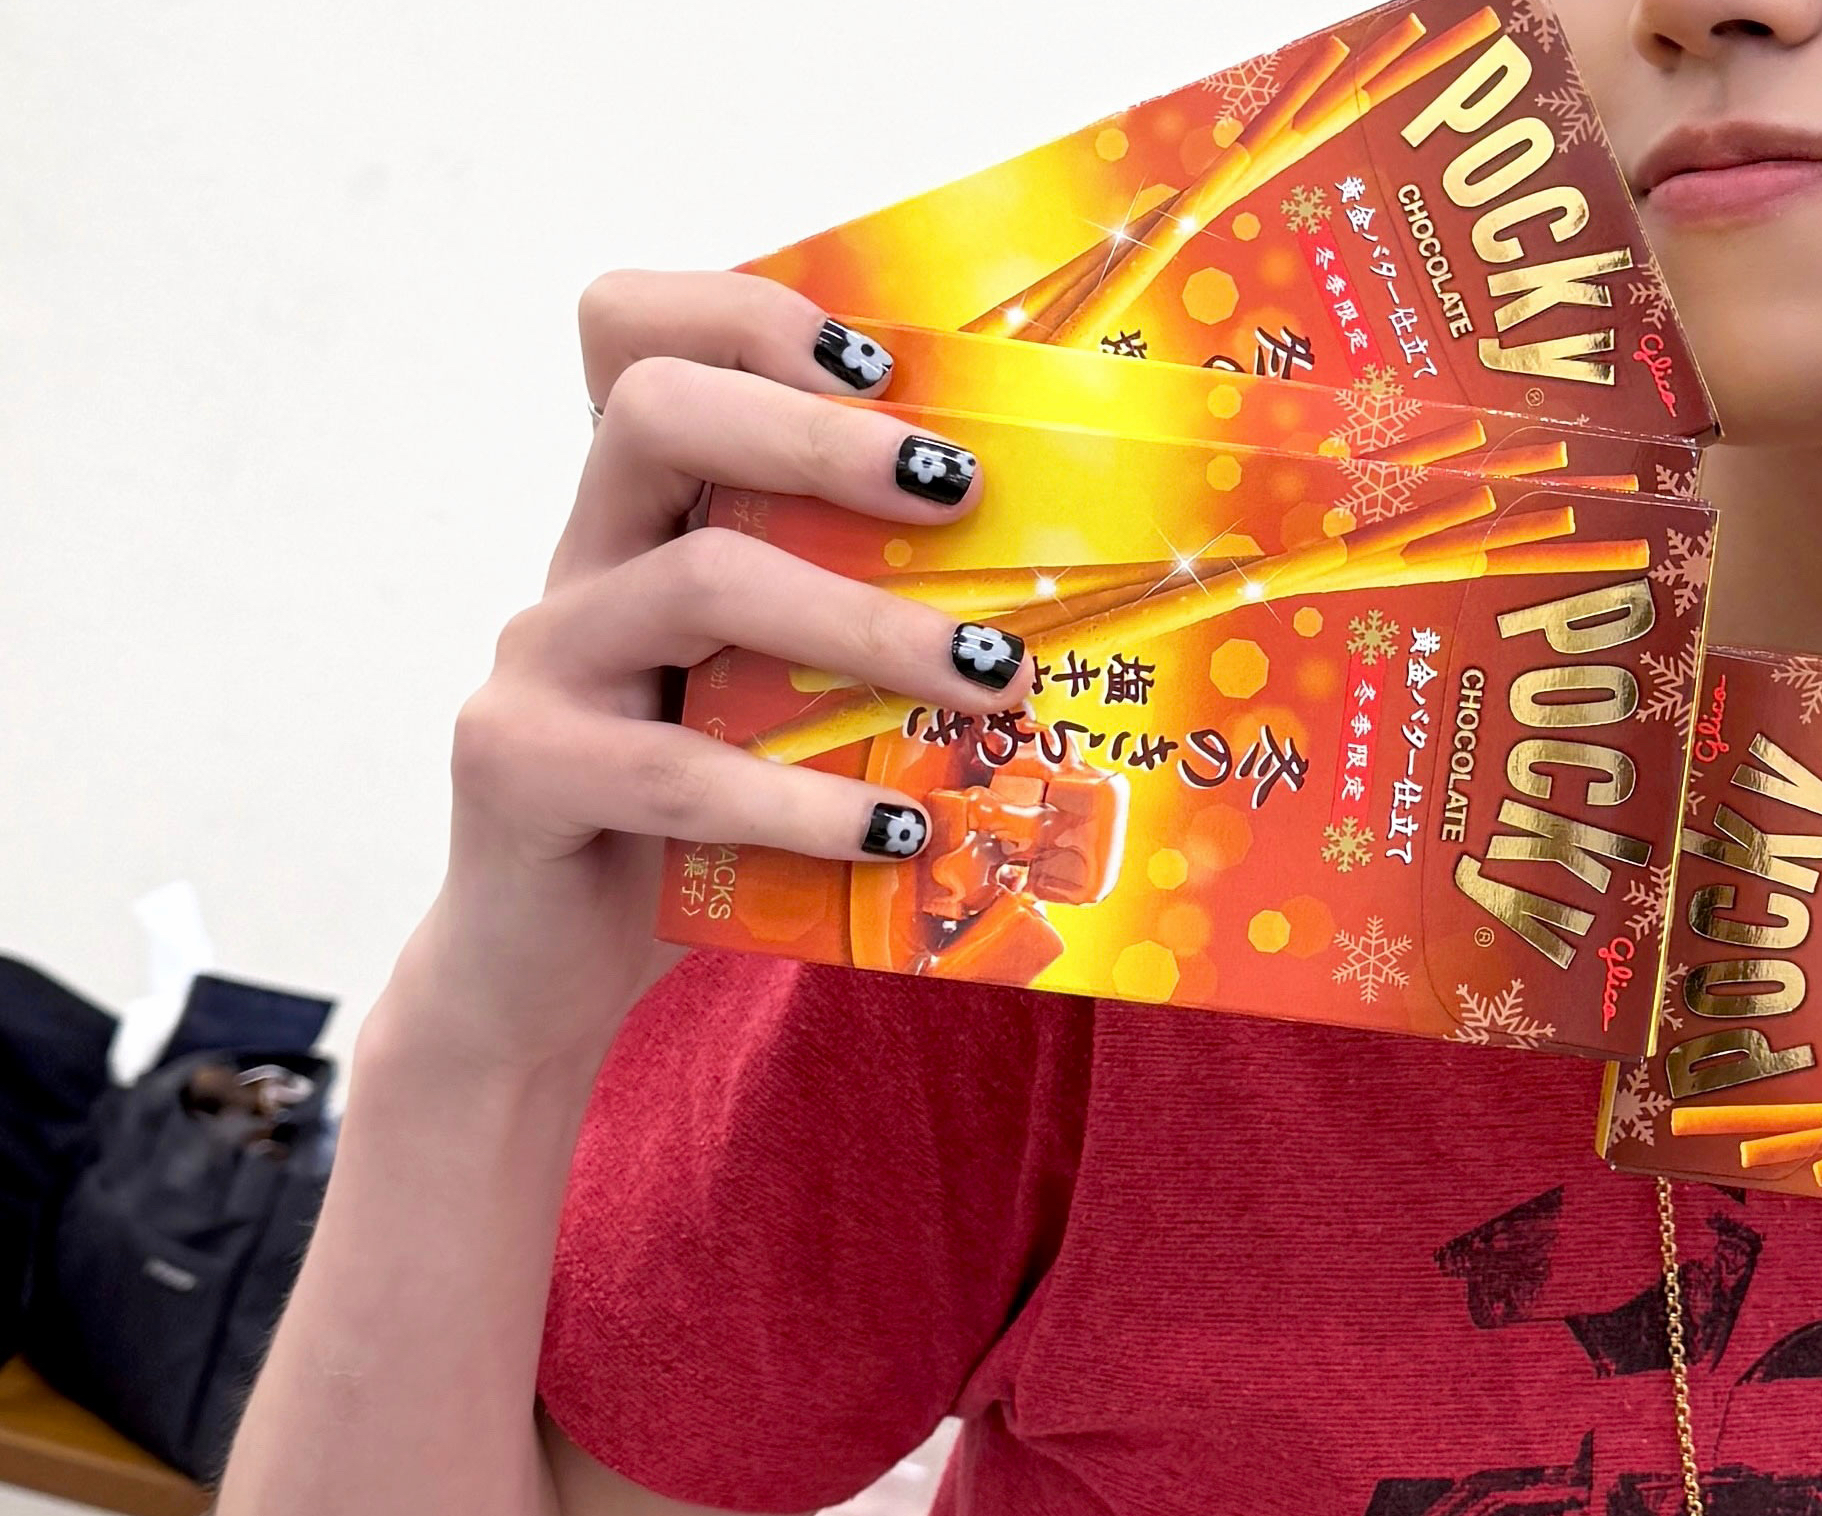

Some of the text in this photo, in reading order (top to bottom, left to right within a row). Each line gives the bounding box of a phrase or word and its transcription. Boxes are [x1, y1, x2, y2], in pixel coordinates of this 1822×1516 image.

[1315, 246, 1368, 355] 冬季限定
[1334, 176, 1438, 380] 黄金バター仕立て
[1398, 183, 1474, 339] CHOCOLATE
[1632, 333, 1679, 418] Glico
[1340, 679, 1379, 801] 冬季限定
[1386, 626, 1440, 865] 黄金バター仕立て
[1441, 668, 1485, 843] CHOCOLATE
[1695, 674, 1729, 762] Glico
[709, 844, 739, 919] ACKS
[1598, 937, 1635, 1031] Glico
